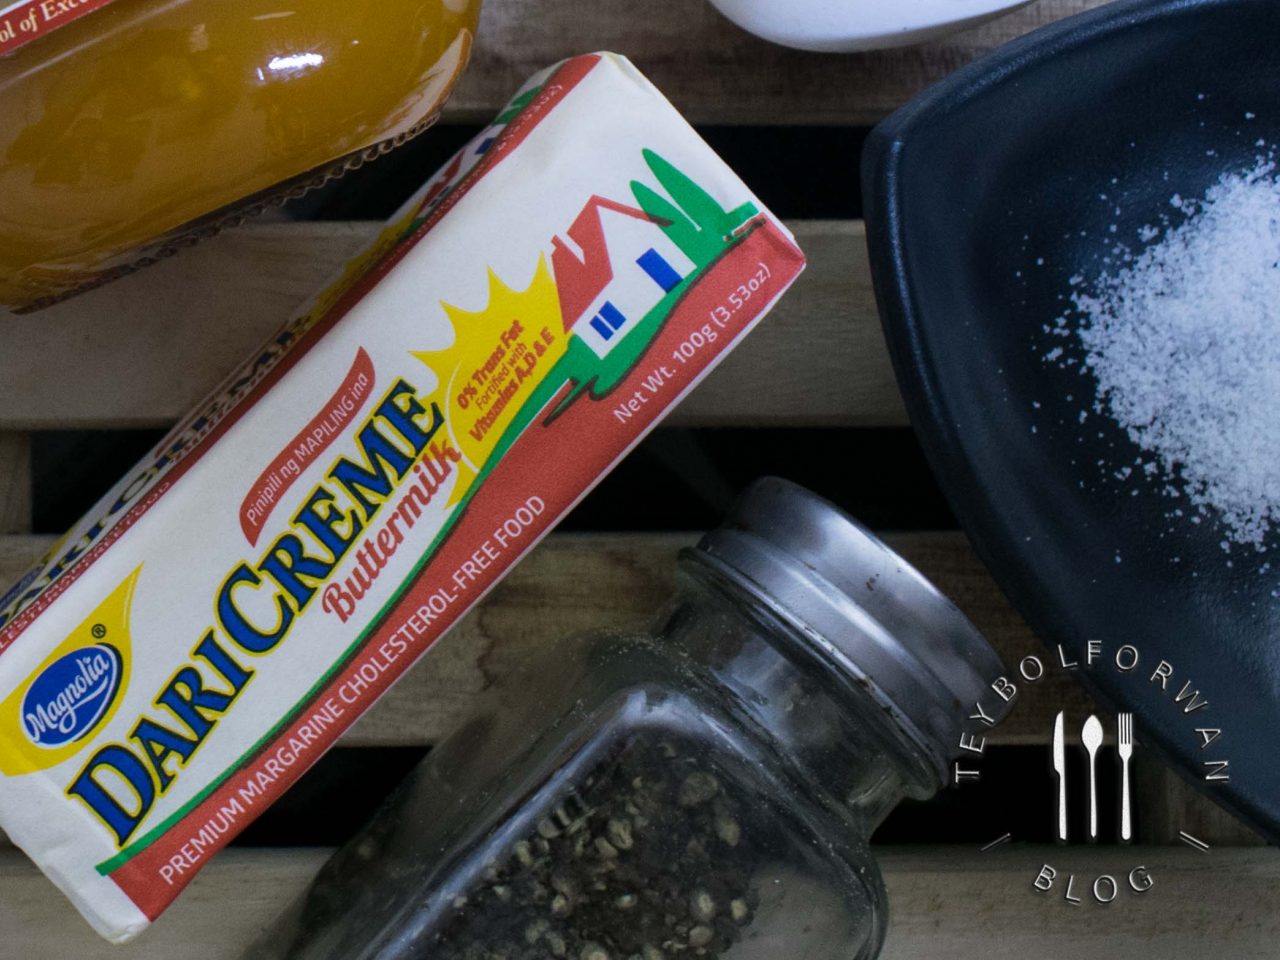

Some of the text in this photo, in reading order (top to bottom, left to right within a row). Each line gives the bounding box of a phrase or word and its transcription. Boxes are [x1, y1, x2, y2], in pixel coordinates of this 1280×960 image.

[19, 7, 39, 33] of
[457, 319, 524, 410] 0% Trans Fat
[469, 378, 520, 442] Vitamins
[540, 326, 555, 346] E
[475, 342, 528, 410] Fortified with
[612, 262, 771, 424] Net Wt. 100g (3.53oz)
[246, 372, 369, 526] Pinipili ng MAPILING ina
[322, 438, 462, 624] Buttermilk
[26, 653, 110, 743] Magnolia
[158, 494, 546, 886] PREMIUM MARGARINE CHOLESTEROL-FREE FOOD
